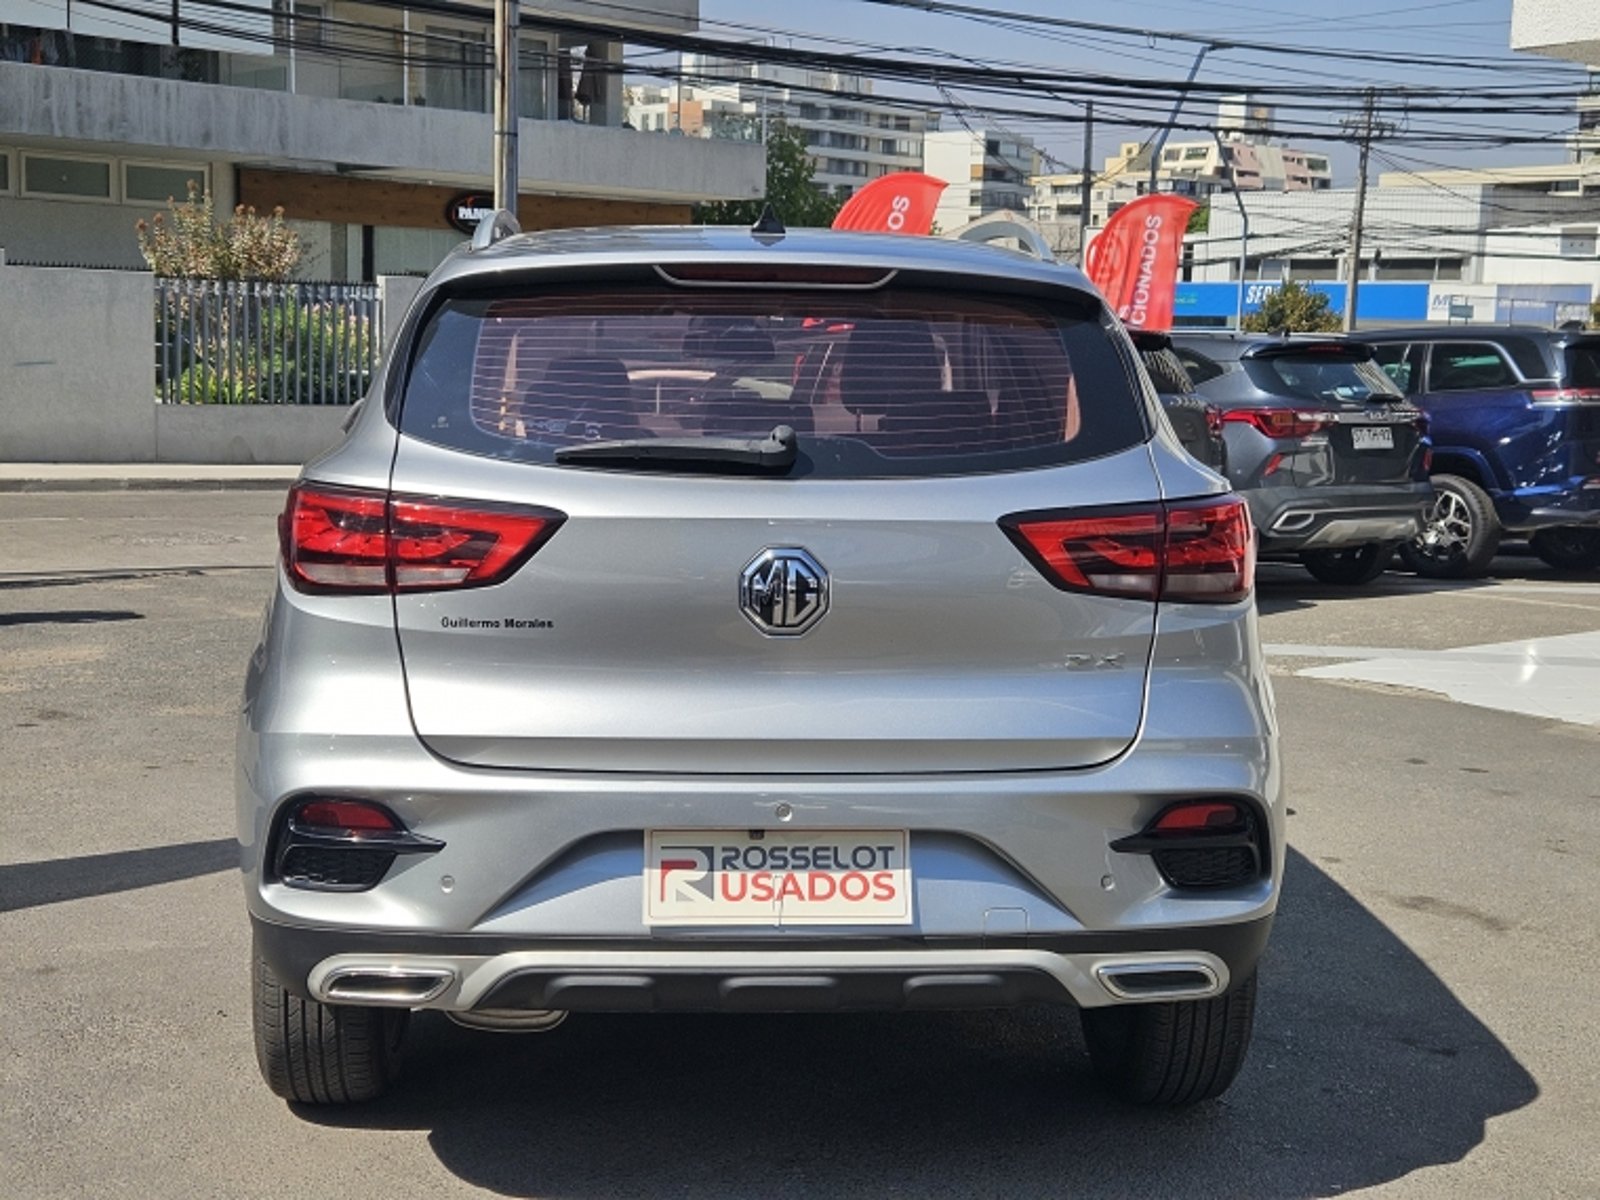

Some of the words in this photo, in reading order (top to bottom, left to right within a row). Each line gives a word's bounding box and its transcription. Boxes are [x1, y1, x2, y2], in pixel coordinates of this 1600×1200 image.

[1130, 215, 1162, 326] CIONADOS
[750, 557, 820, 628] MG
[441, 616, 500, 628] Guillermo
[504, 618, 554, 628] Morales
[721, 846, 895, 870] ROSSELOT
[721, 871, 896, 902] USADOS
